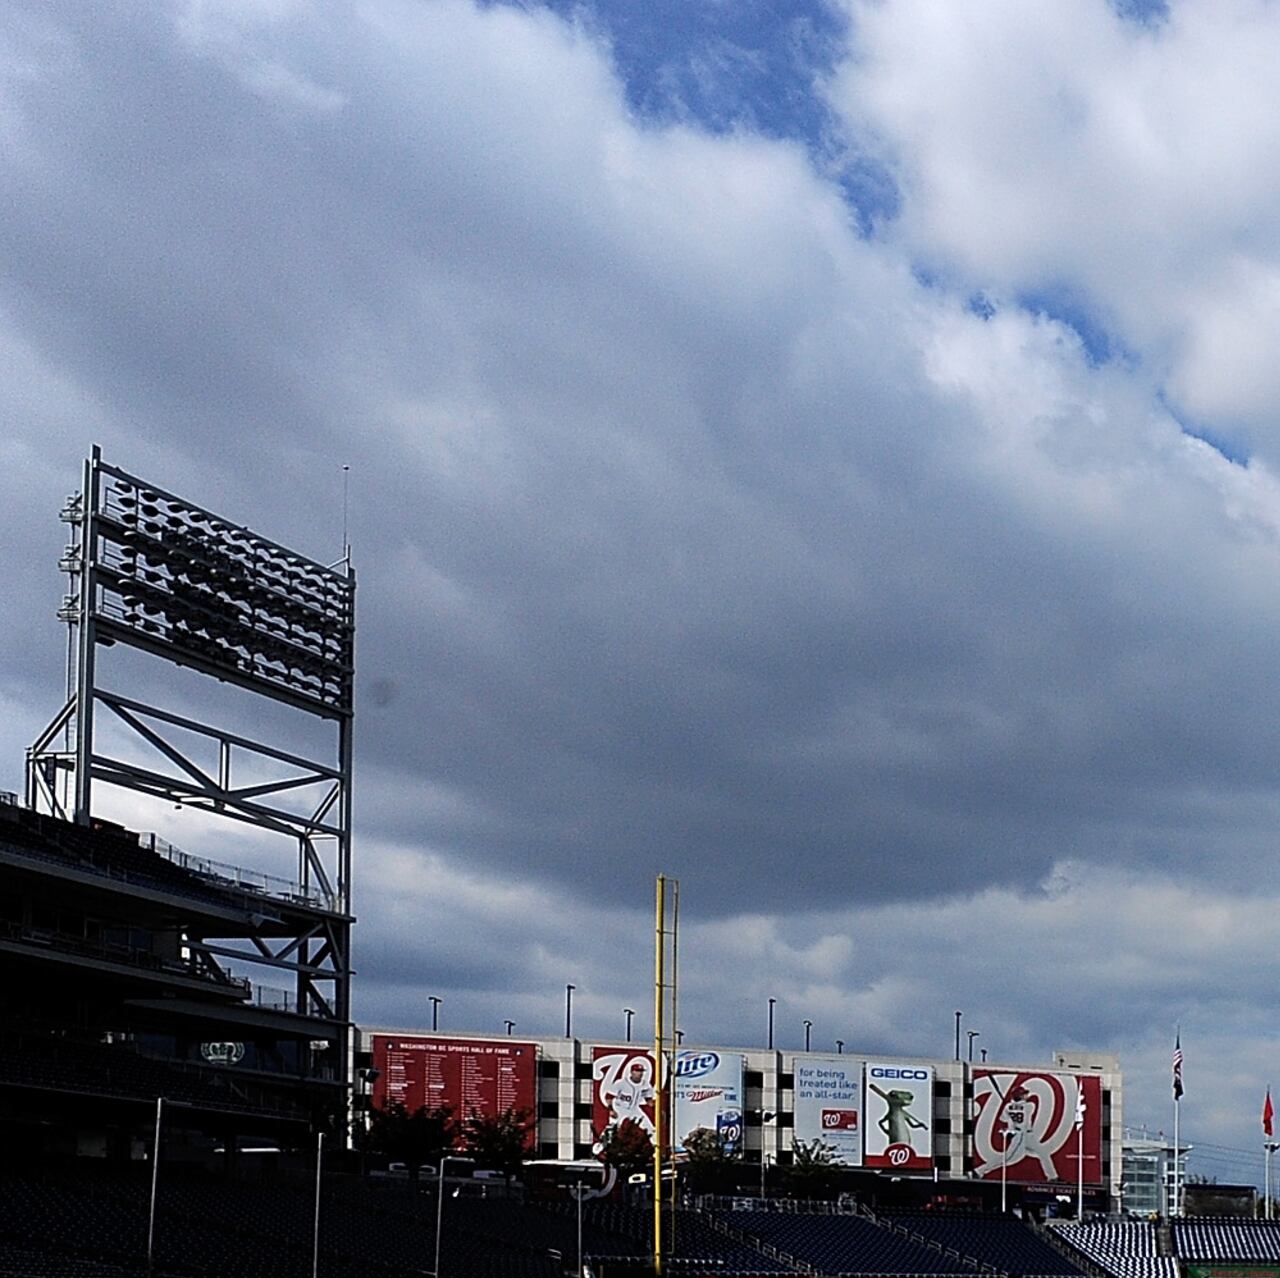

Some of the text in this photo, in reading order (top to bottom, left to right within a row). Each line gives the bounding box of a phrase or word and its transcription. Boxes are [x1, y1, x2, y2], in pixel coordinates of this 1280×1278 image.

[400, 1043, 437, 1051] WASHINGTON
[447, 1045, 469, 1053] SPORTS
[800, 1068, 845, 1080] for being
[871, 1068, 928, 1080] GEICO
[800, 1079, 857, 1090] treated like
[800, 1091, 812, 1099] an
